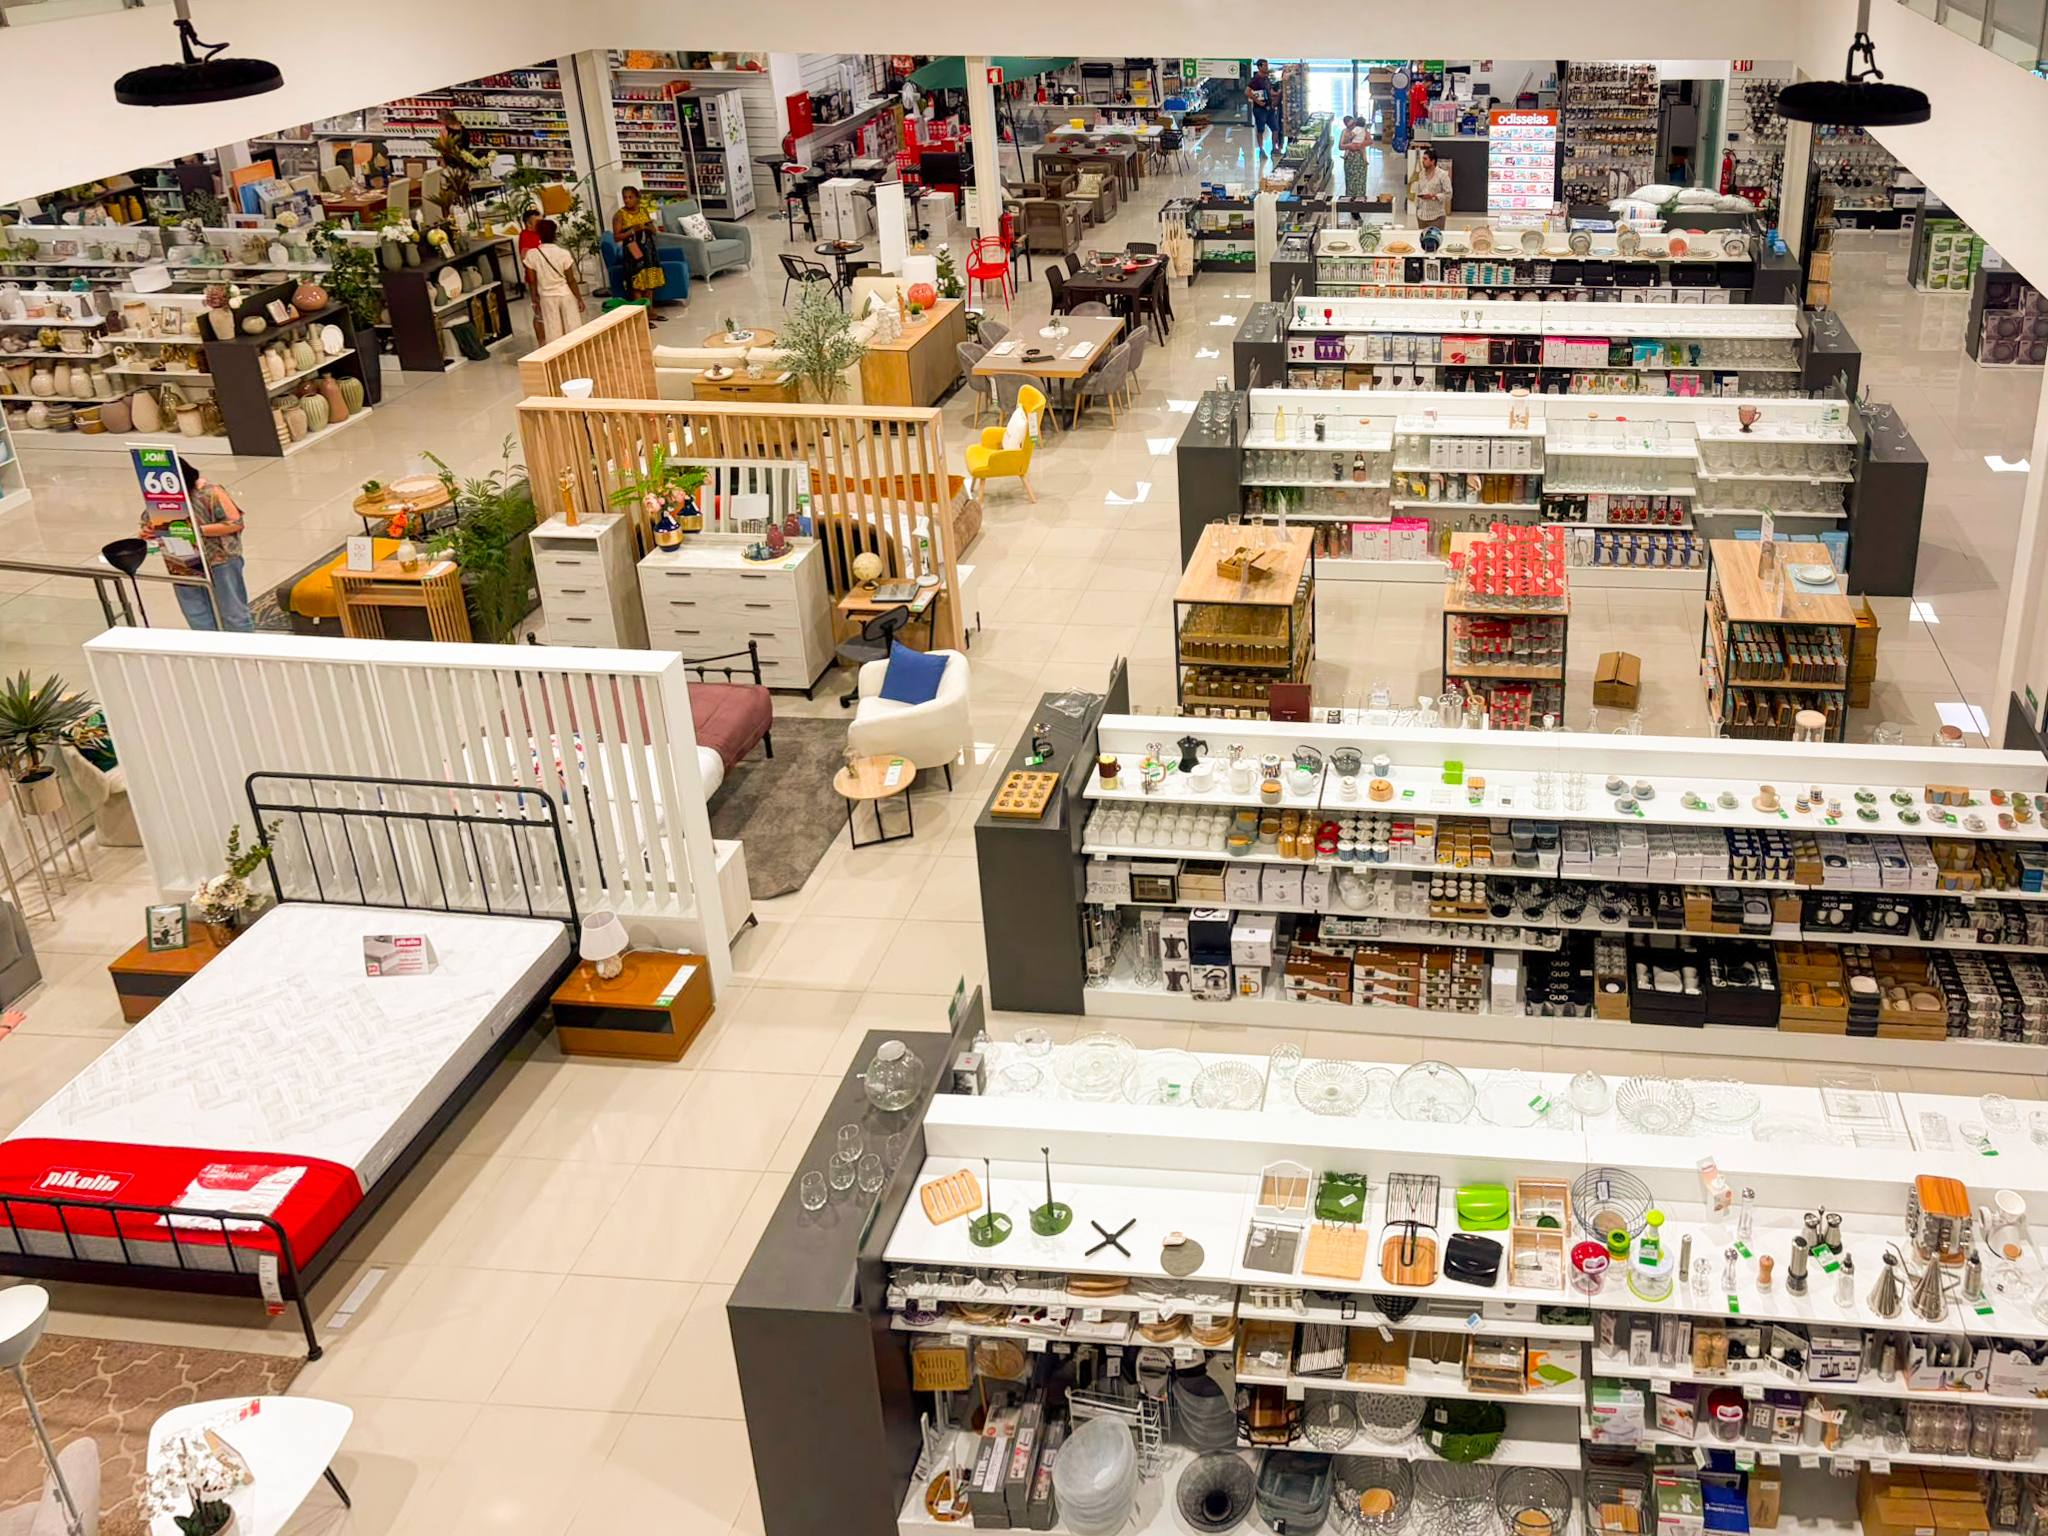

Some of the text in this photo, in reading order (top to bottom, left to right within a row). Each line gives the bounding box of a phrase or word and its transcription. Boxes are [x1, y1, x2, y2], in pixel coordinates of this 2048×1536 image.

[1498, 113, 1548, 125] odisseias
[144, 452, 168, 462] JOM
[144, 471, 180, 494] 60
[40, 1171, 120, 1192] pikolin
